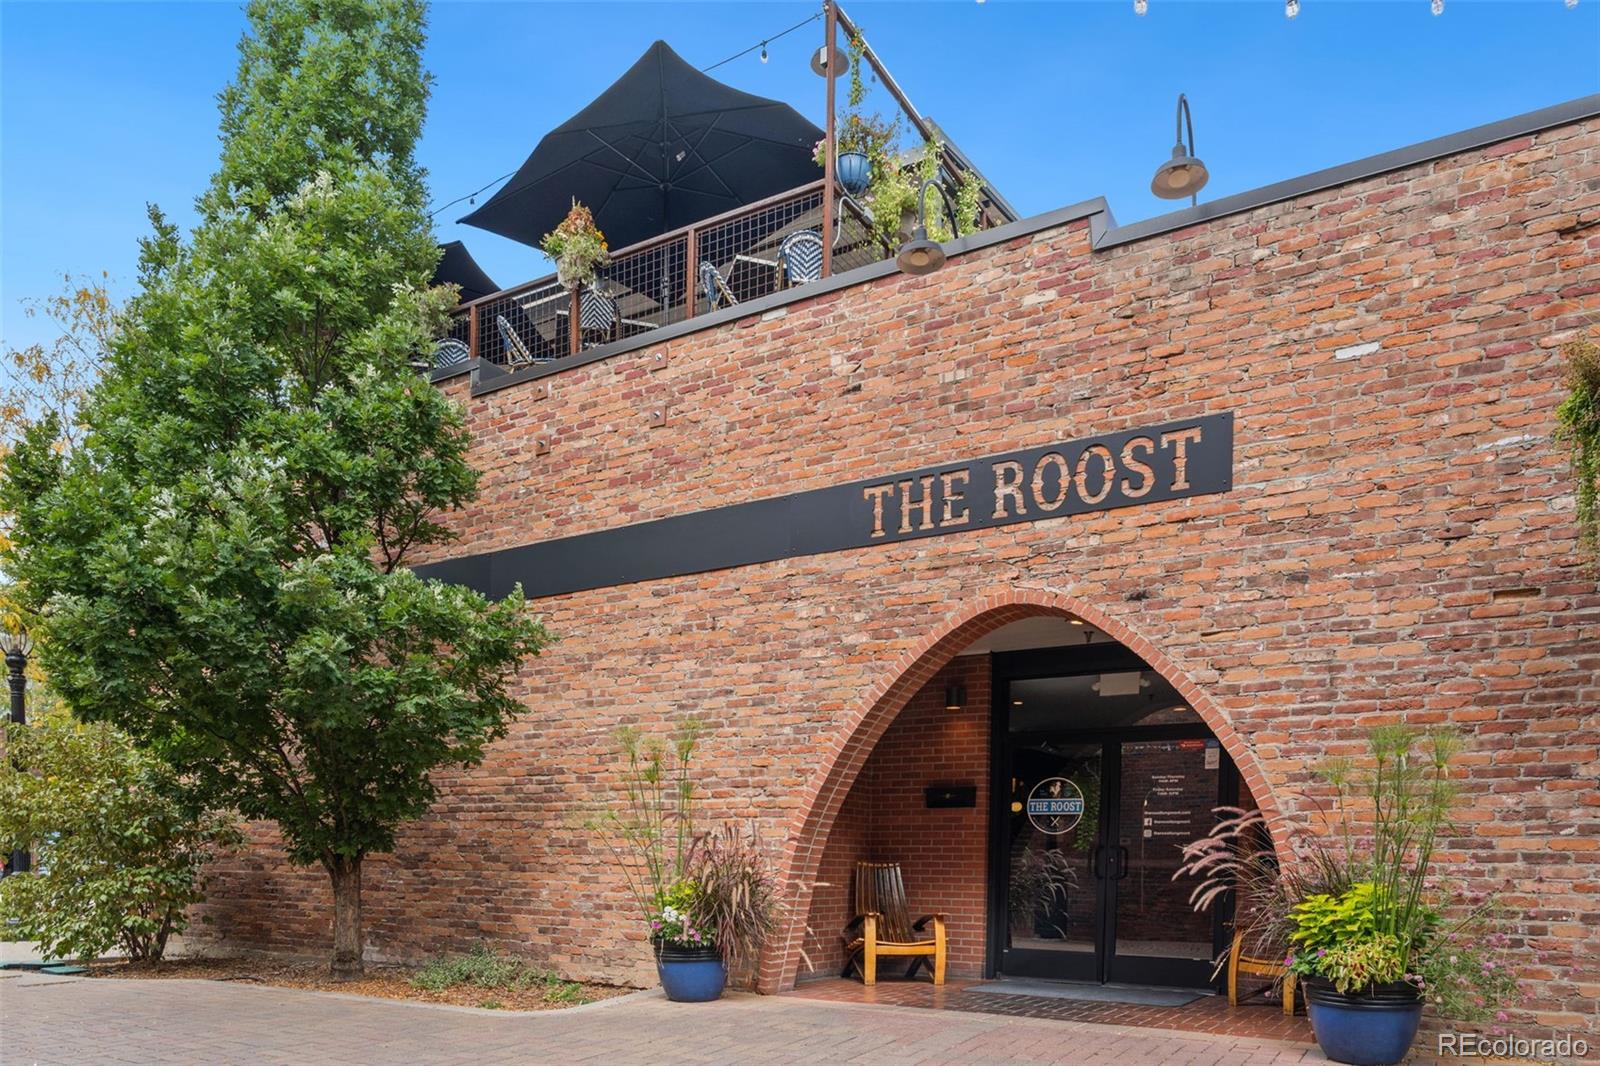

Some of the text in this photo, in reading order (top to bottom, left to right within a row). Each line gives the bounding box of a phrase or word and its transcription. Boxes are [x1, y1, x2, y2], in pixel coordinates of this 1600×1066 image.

[863, 426, 1202, 538] THE ROOST
[1030, 802, 1081, 811] THE ROOST
